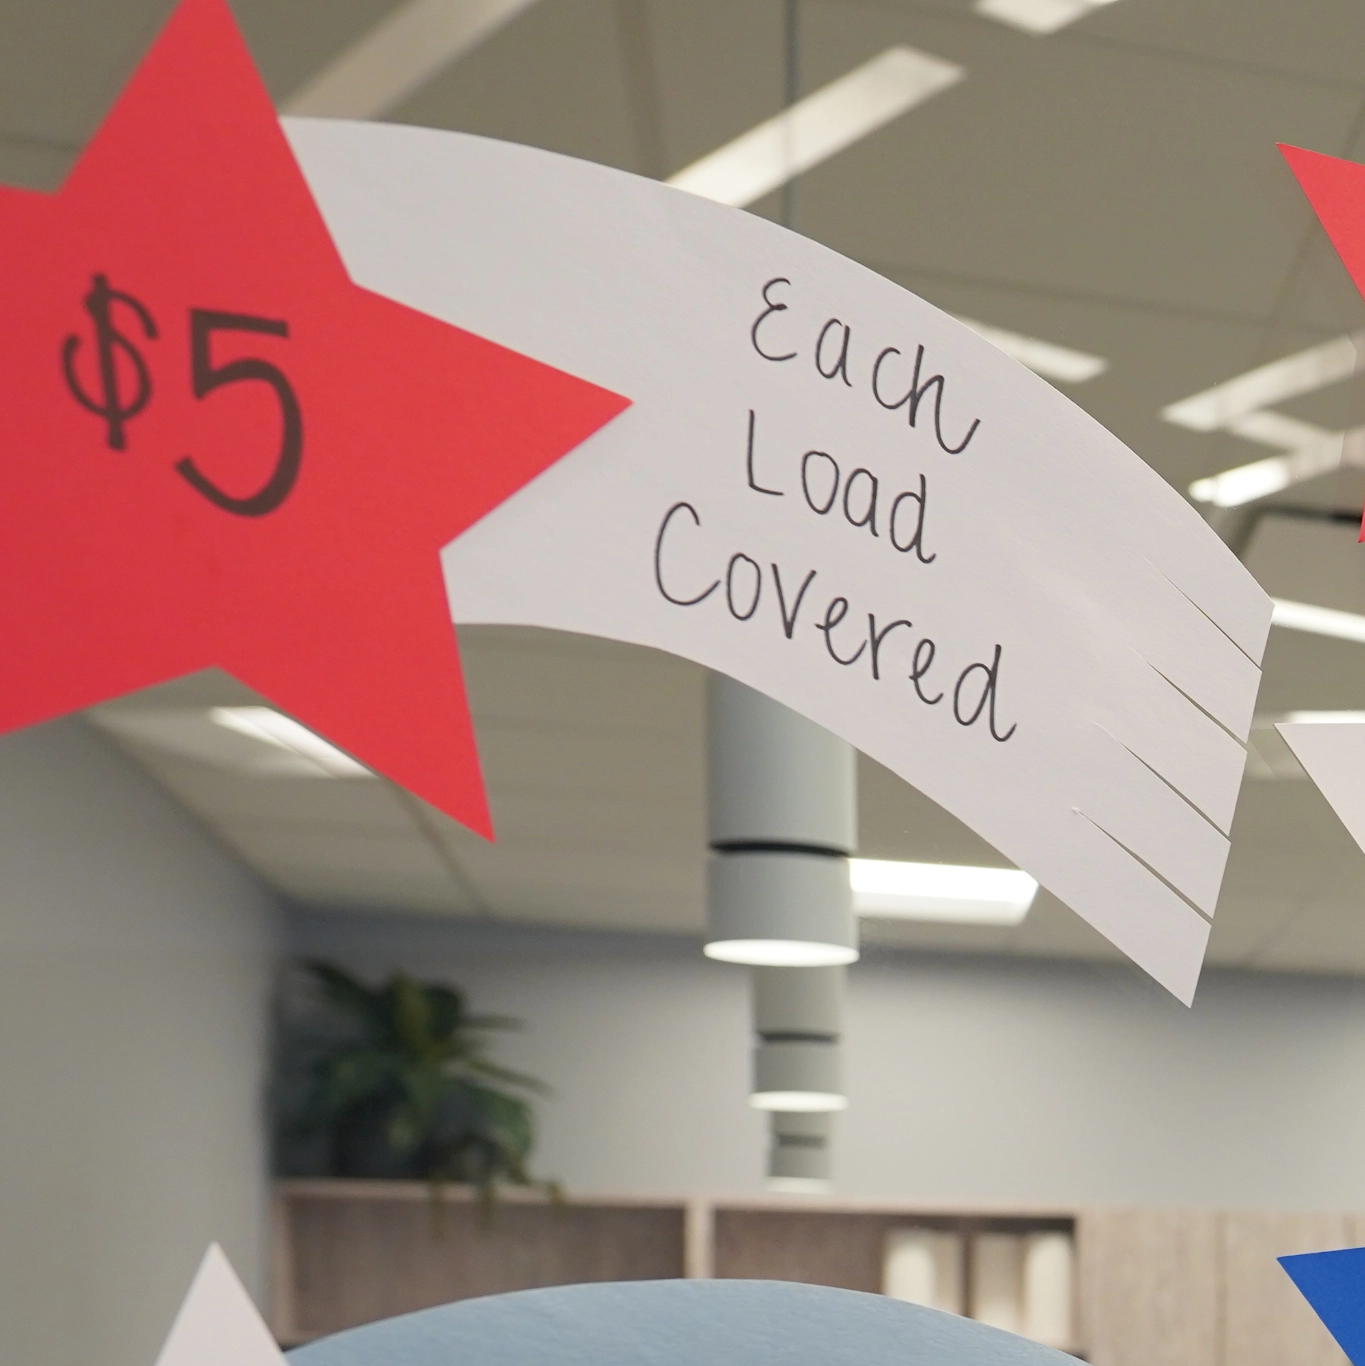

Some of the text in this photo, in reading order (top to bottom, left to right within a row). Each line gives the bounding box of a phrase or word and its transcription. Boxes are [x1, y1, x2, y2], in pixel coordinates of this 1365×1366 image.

[59, 271, 306, 520] $5
[748, 276, 982, 456] Each
[745, 407, 938, 566] Load
[652, 500, 1019, 744] Covered
